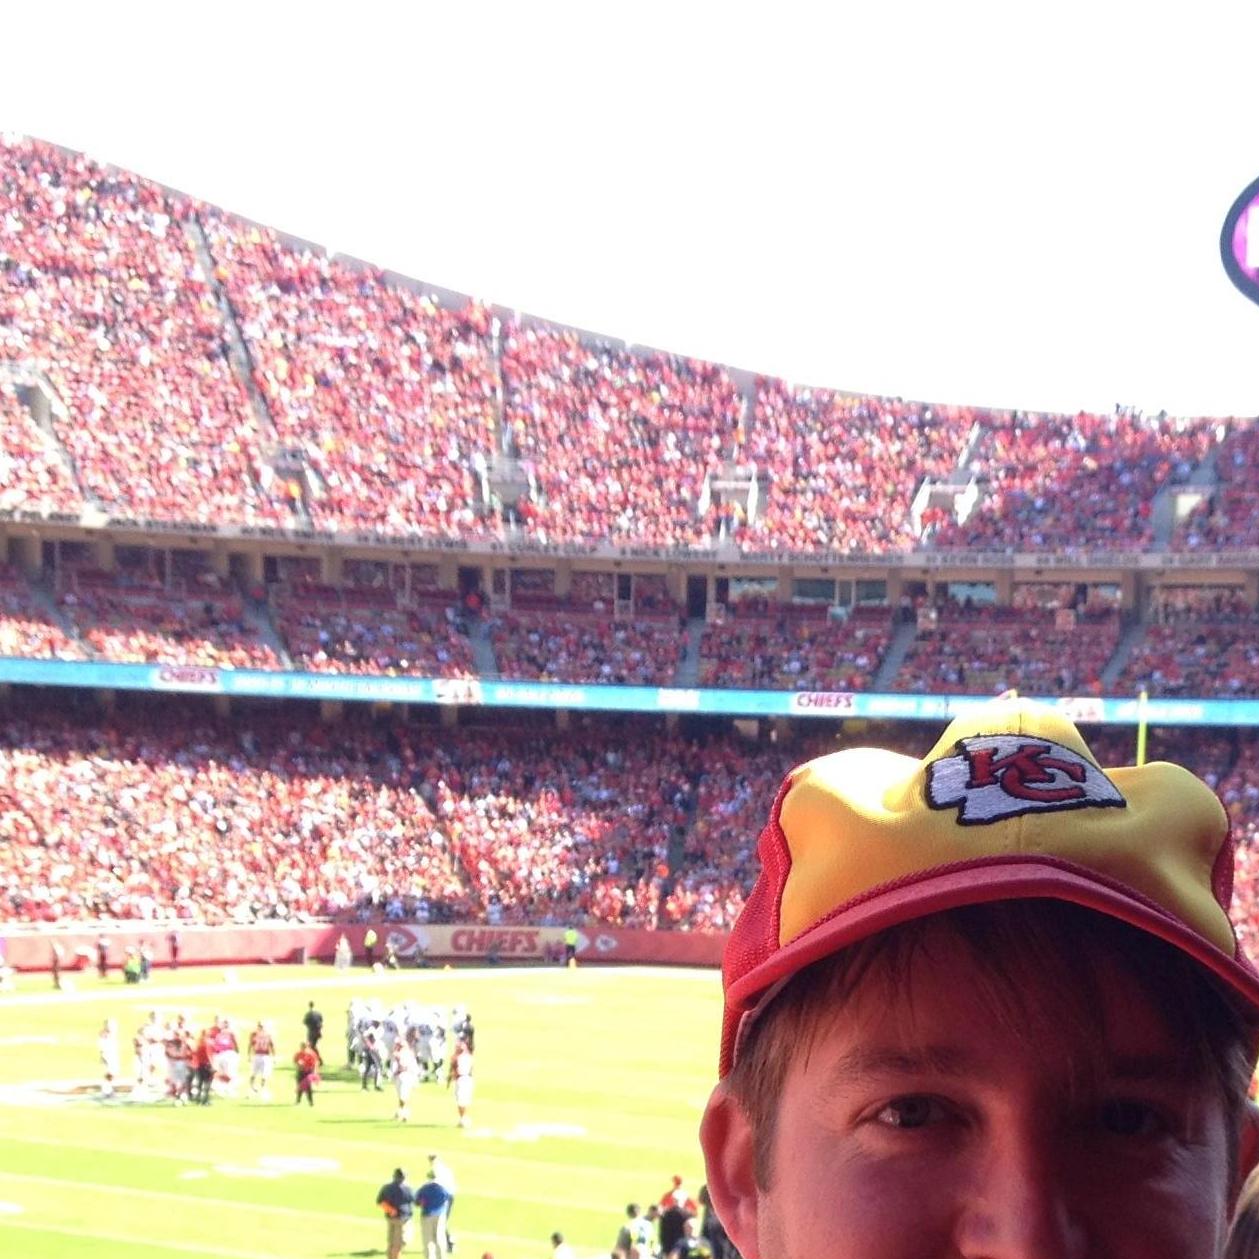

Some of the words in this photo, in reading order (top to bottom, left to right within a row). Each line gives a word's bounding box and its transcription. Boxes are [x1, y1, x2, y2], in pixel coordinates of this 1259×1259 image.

[797, 692, 853, 708] CHIEFS
[966, 744, 1086, 803] KC
[451, 928, 540, 952] CHIEFS
